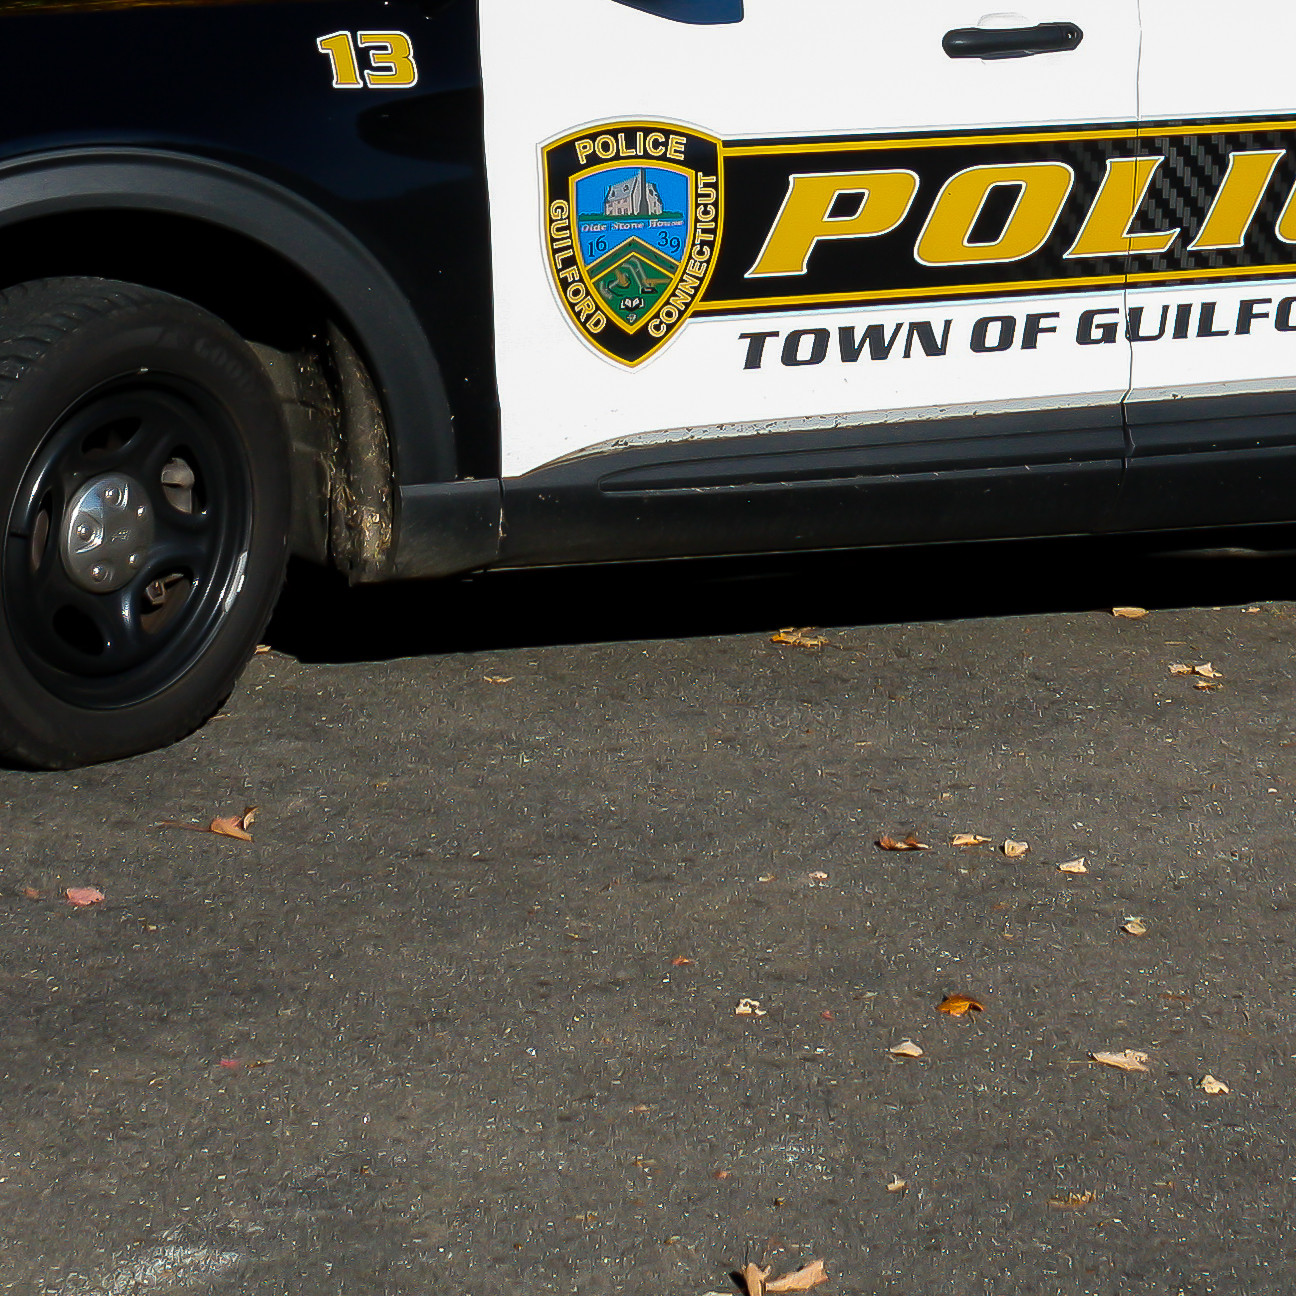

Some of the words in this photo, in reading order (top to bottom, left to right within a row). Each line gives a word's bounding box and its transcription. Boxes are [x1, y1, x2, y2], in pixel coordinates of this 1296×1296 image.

[316, 30, 418, 89] 13
[575, 132, 687, 164] POLICE
[581, 223, 606, 232] Olde
[611, 221, 644, 230] Stone
[588, 235, 607, 257] 16
[657, 230, 681, 253] 39
[648, 172, 717, 338] CONNECTICUT
[550, 199, 607, 334] GUILFORD
[738, 319, 953, 369] TOWN
[970, 311, 1060, 353] OF
